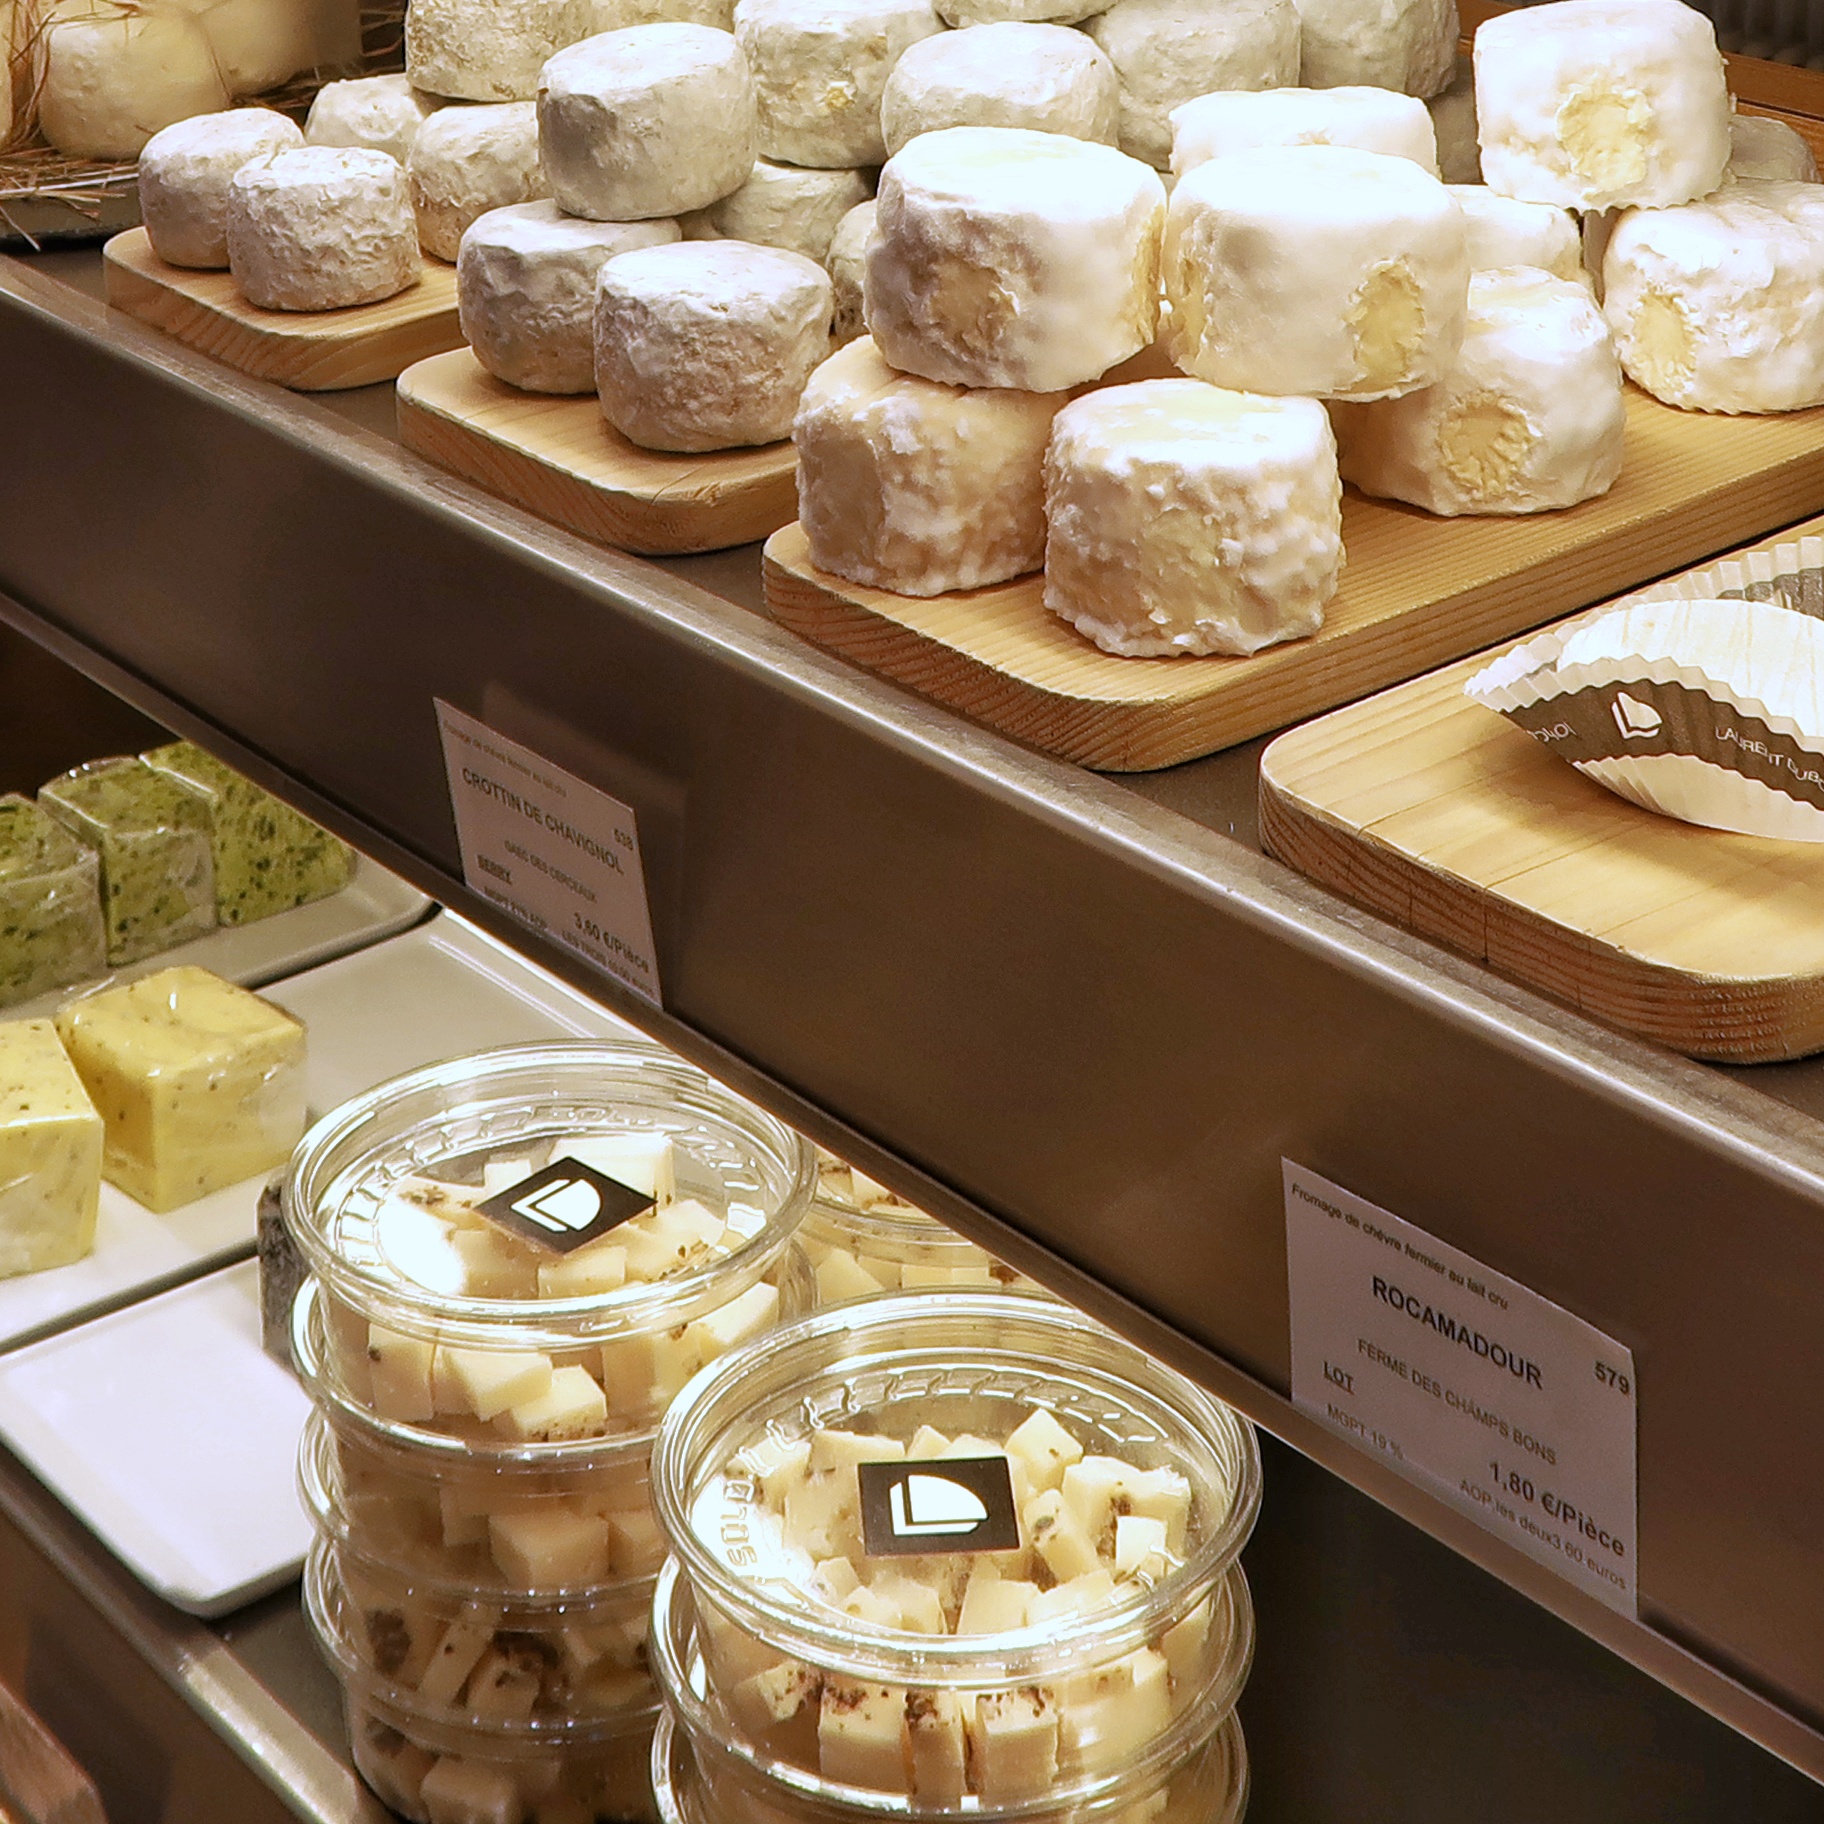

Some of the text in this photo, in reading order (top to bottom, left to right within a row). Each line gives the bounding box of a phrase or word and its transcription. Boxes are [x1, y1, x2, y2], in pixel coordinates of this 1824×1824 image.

[1715, 726, 1784, 767] LAURENT
[462, 767, 626, 877] CROTTIN DE CHAVIGNOL
[1291, 1182, 1343, 1221] Fromage
[1344, 1211, 1361, 1230] de
[1404, 1241, 1448, 1277] fermier
[1448, 1268, 1465, 1287] au
[1466, 1275, 1486, 1298] lait
[1488, 1290, 1510, 1312] cru
[1321, 1359, 1355, 1395] LOT
[1371, 1273, 1544, 1391] ROCAMADOUR
[1593, 1358, 1632, 1396] 579
[1326, 1401, 1368, 1441] MGPT
[1370, 1427, 1389, 1452] 19
[1357, 1337, 1558, 1467] FERME DES CHAMPS BONS
[1489, 1460, 1626, 1558] 1,80 €/Pièce
